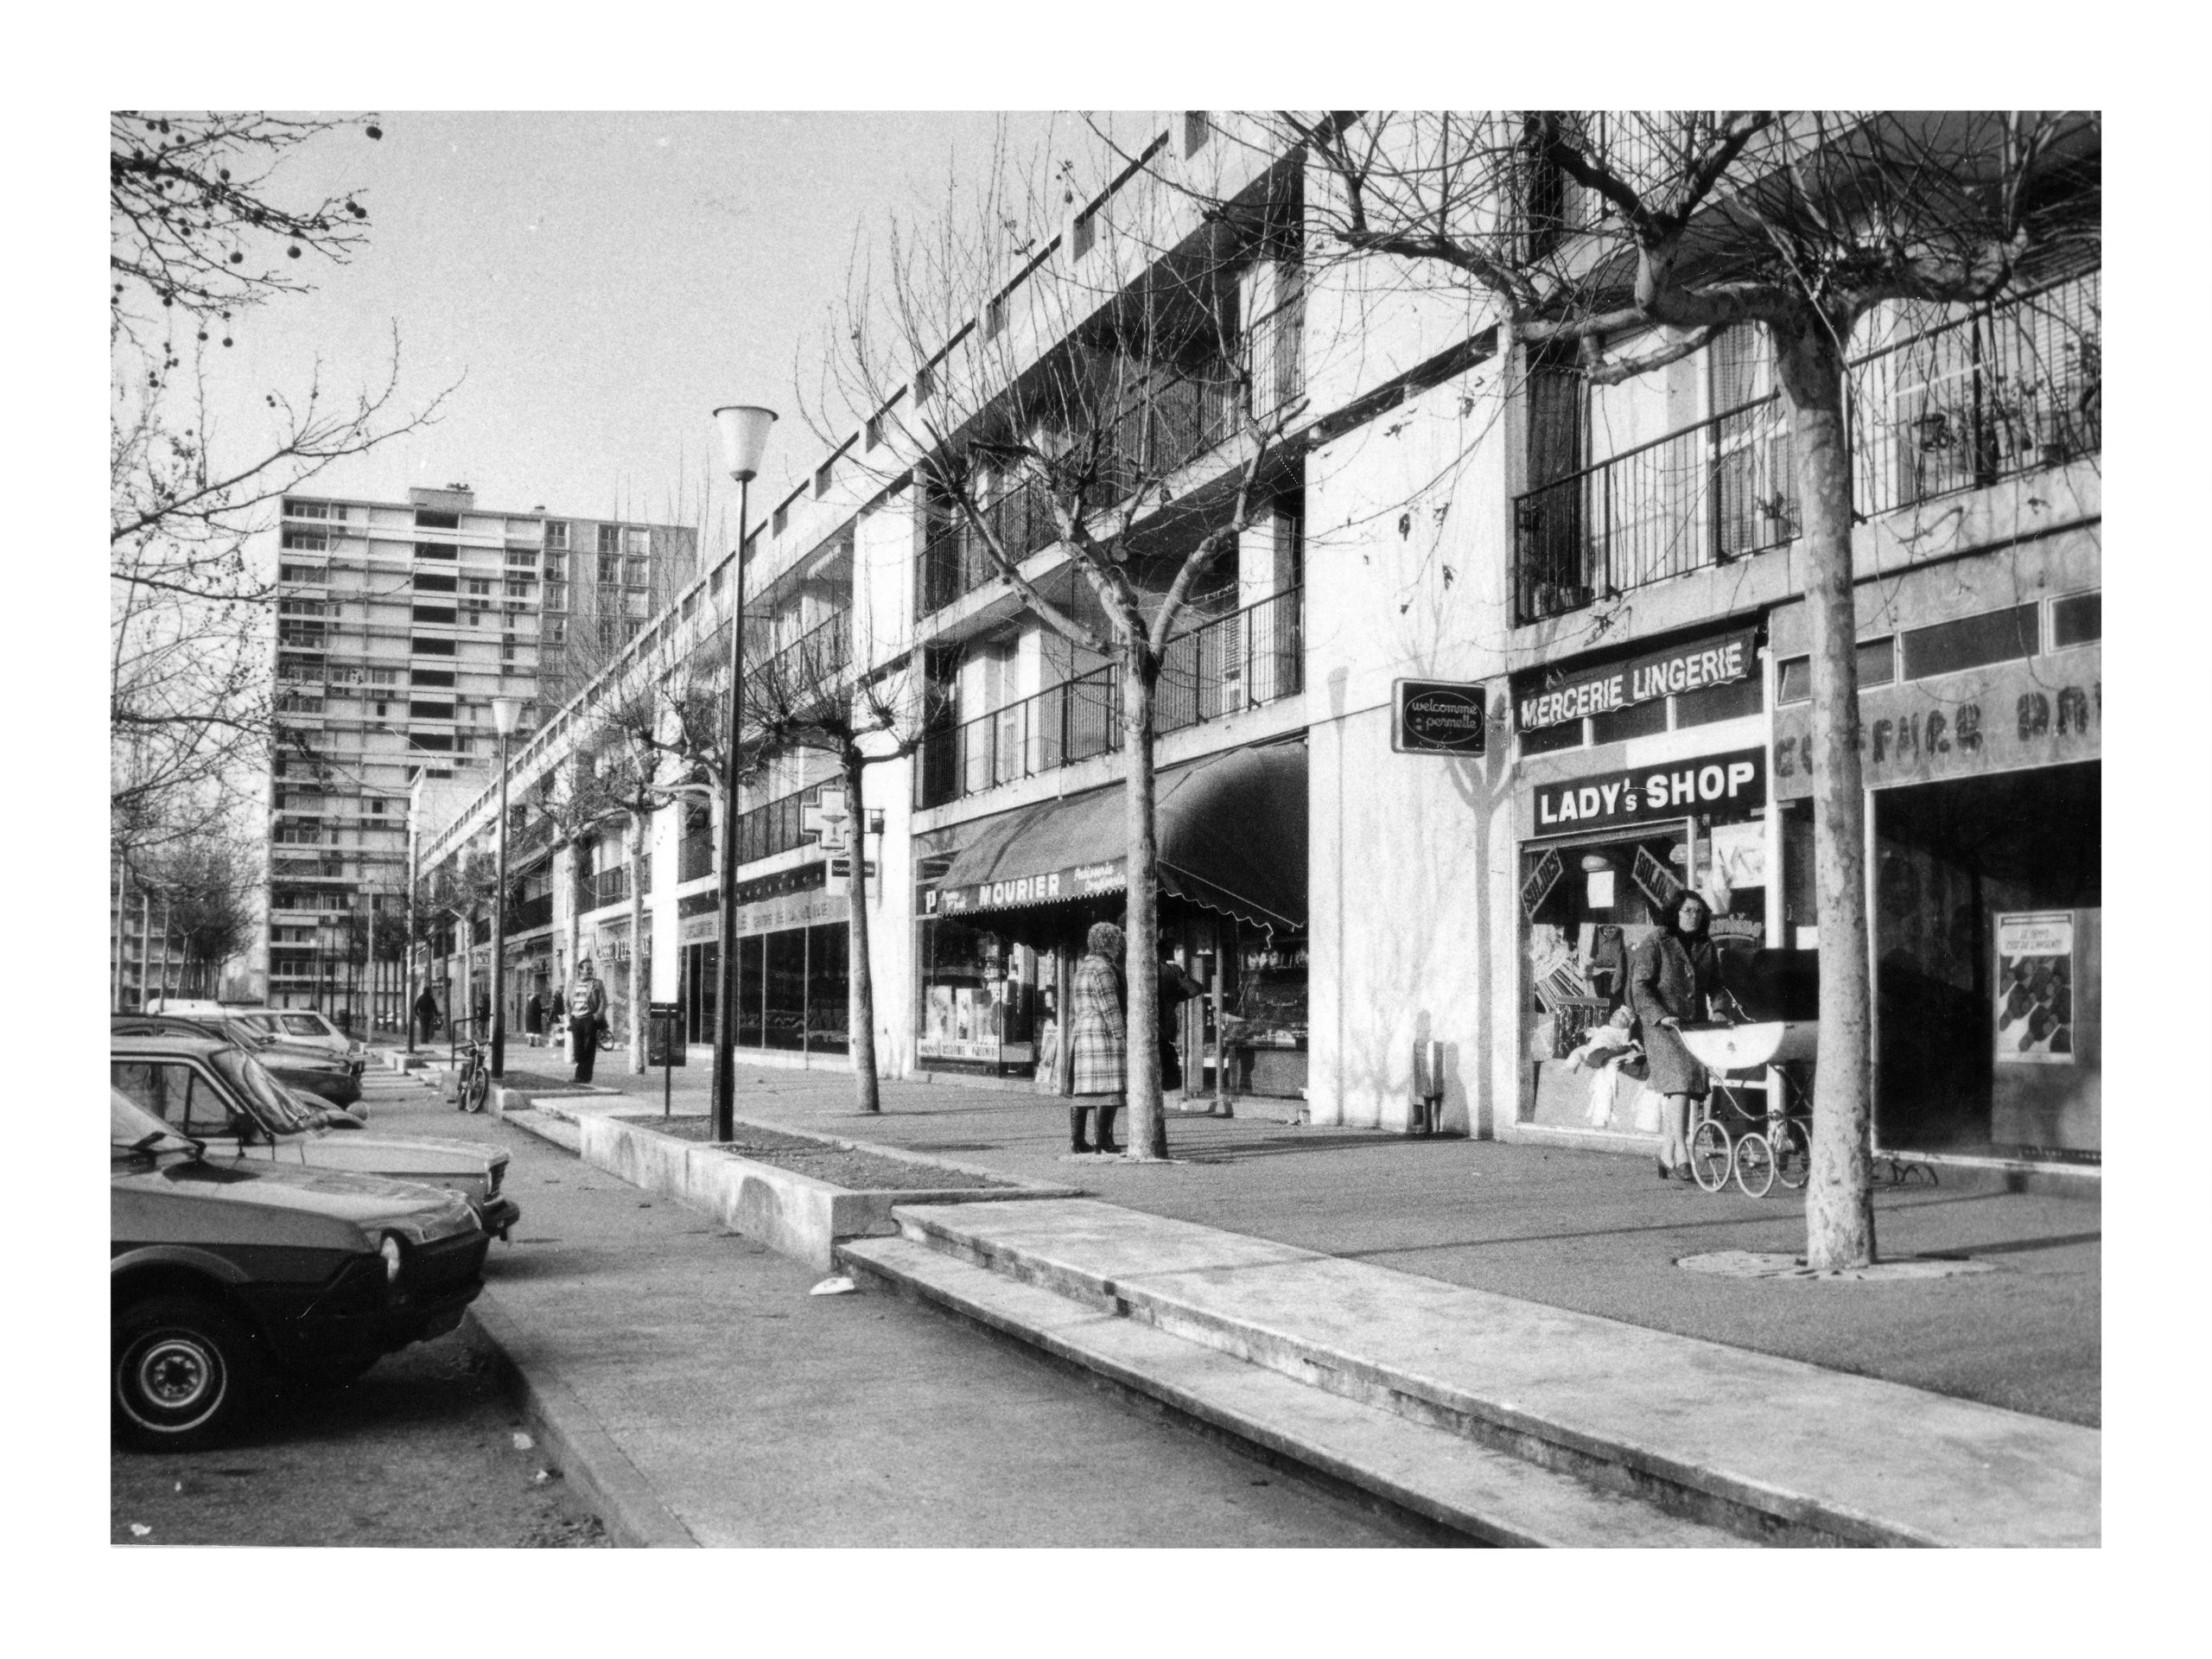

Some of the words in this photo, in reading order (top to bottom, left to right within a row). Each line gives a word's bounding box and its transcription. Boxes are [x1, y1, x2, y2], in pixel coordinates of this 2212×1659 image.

[1521, 674, 1624, 728] MERCERIE
[1633, 642, 1743, 700] LINGERIE
[1773, 702, 1985, 777] COFURE
[1541, 778, 1637, 824] LADY's
[1646, 761, 1755, 809] SHOP
[978, 873, 1060, 906] MOURIER
